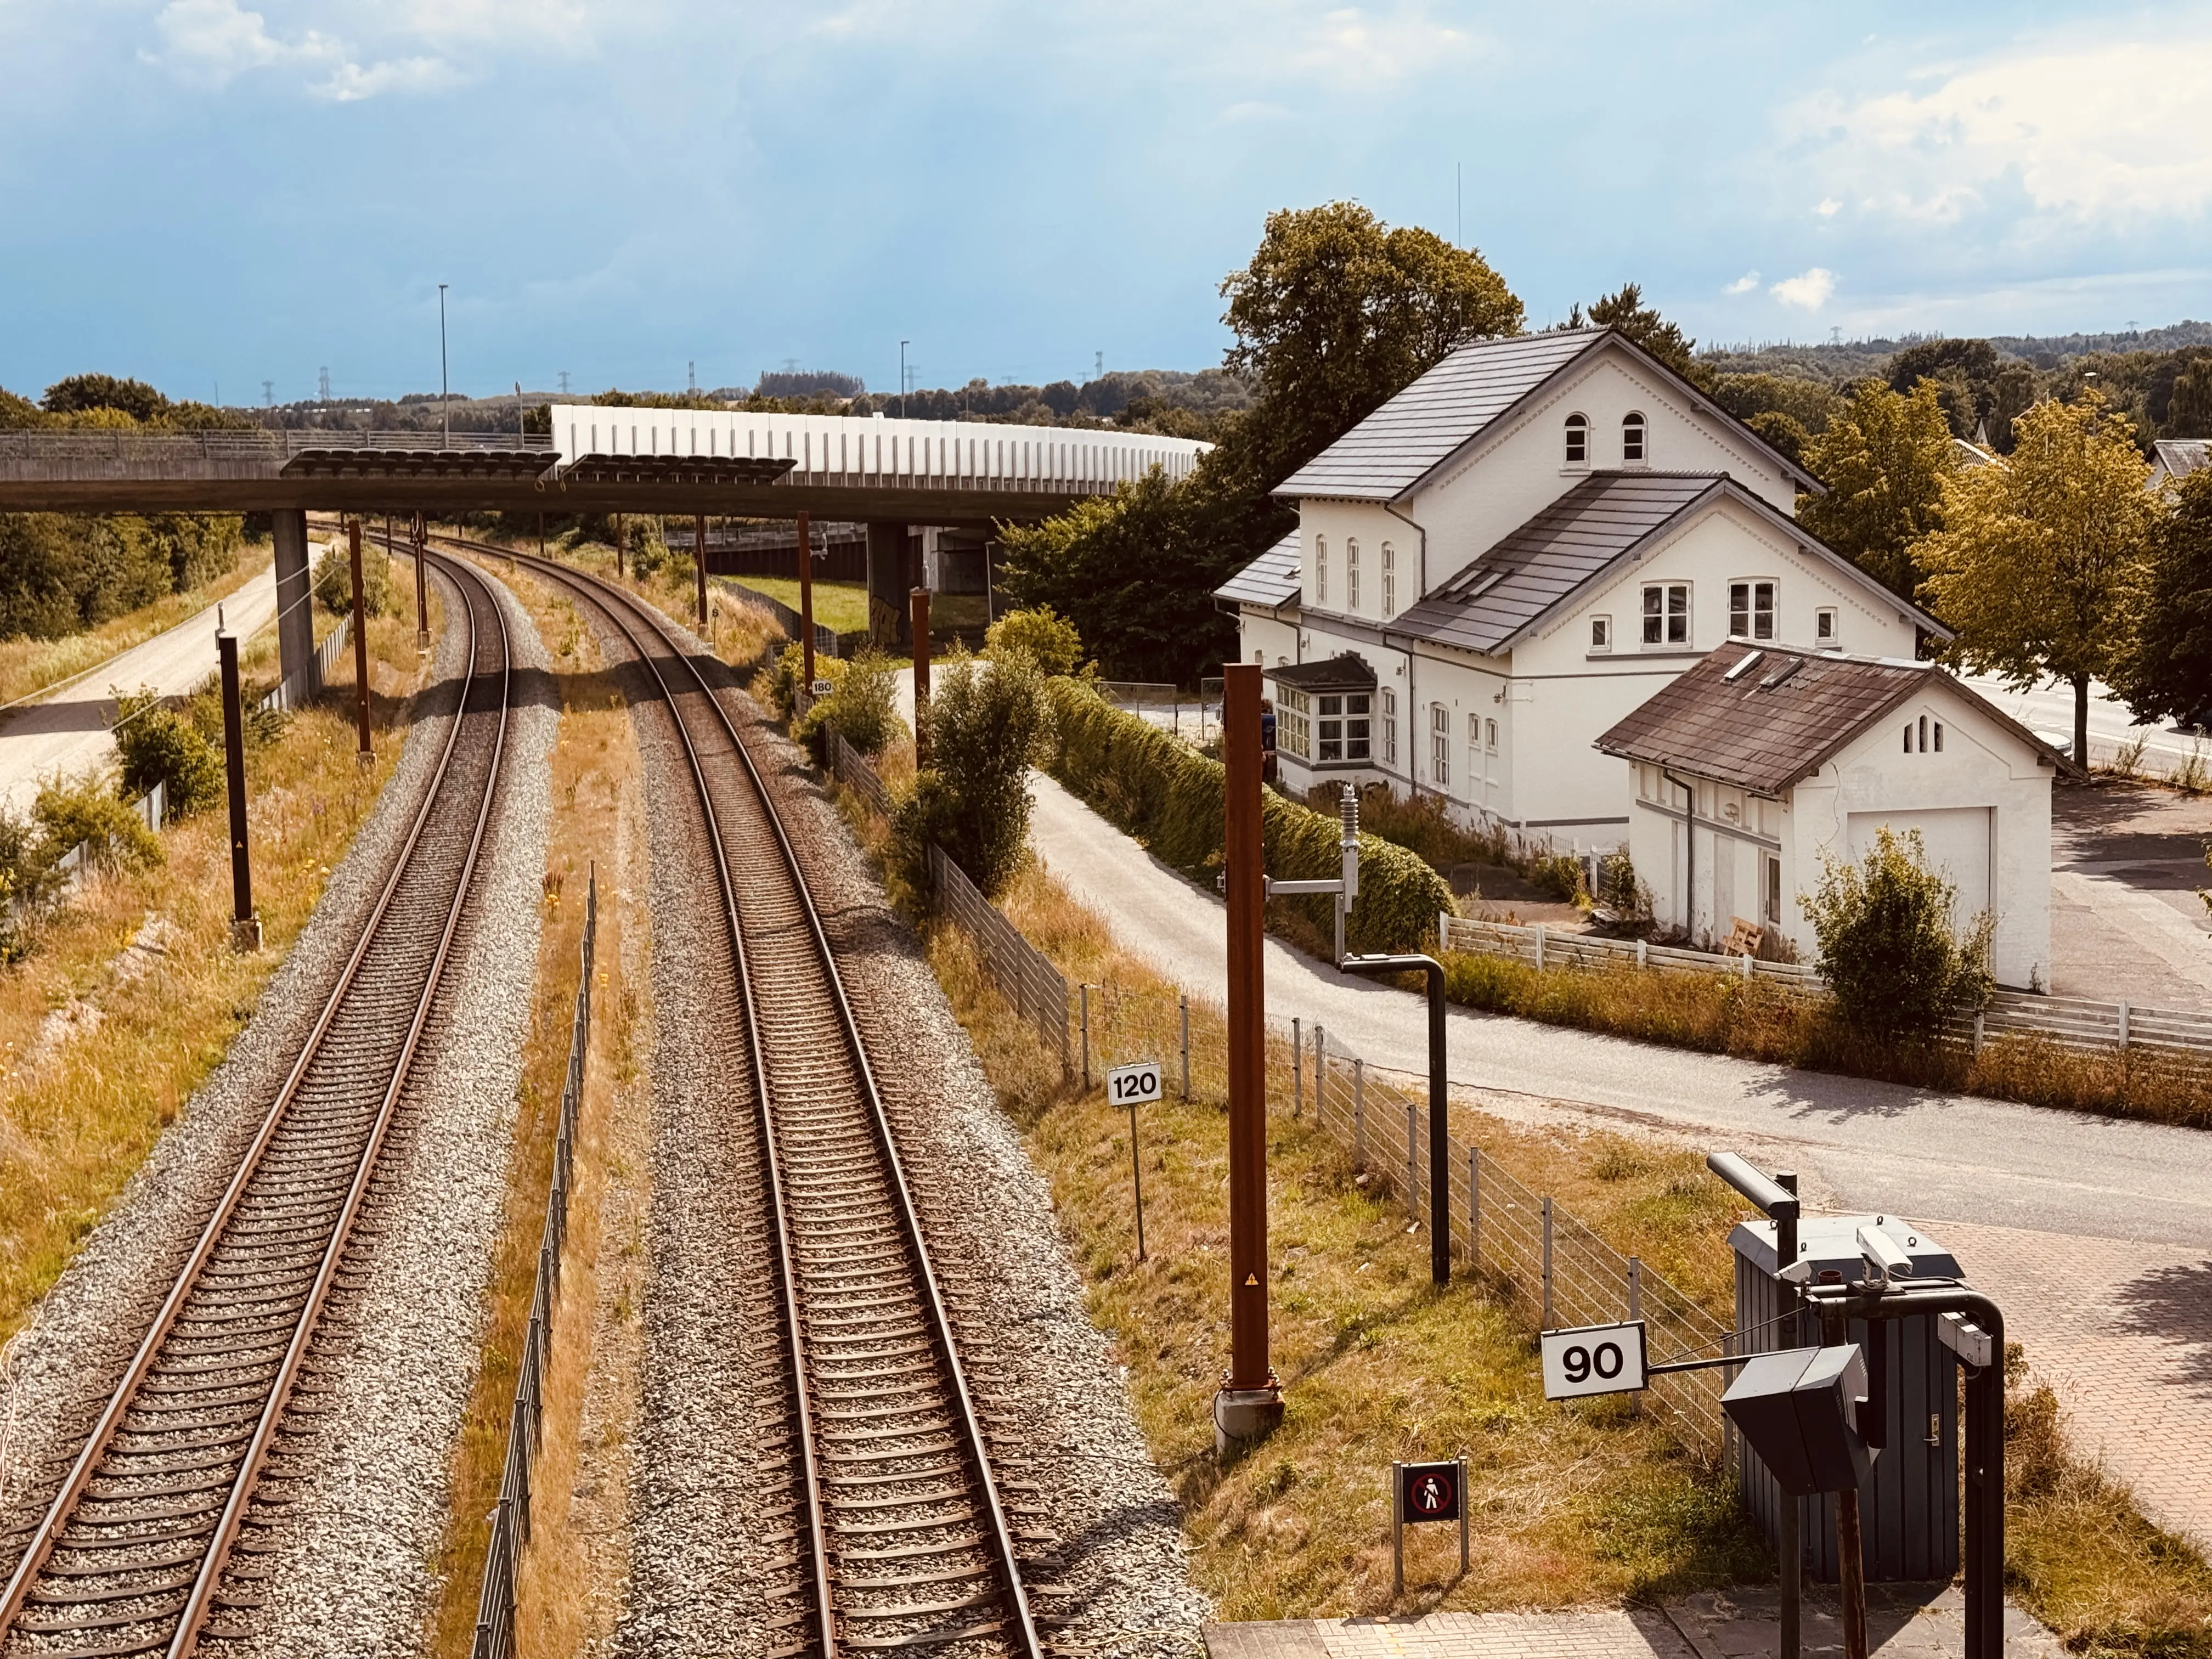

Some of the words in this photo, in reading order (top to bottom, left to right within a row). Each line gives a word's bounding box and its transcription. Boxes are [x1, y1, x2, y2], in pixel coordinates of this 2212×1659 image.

[815, 682, 832, 692] 180
[1114, 1072, 1156, 1099] 120
[1563, 1342, 1623, 1384] 90
